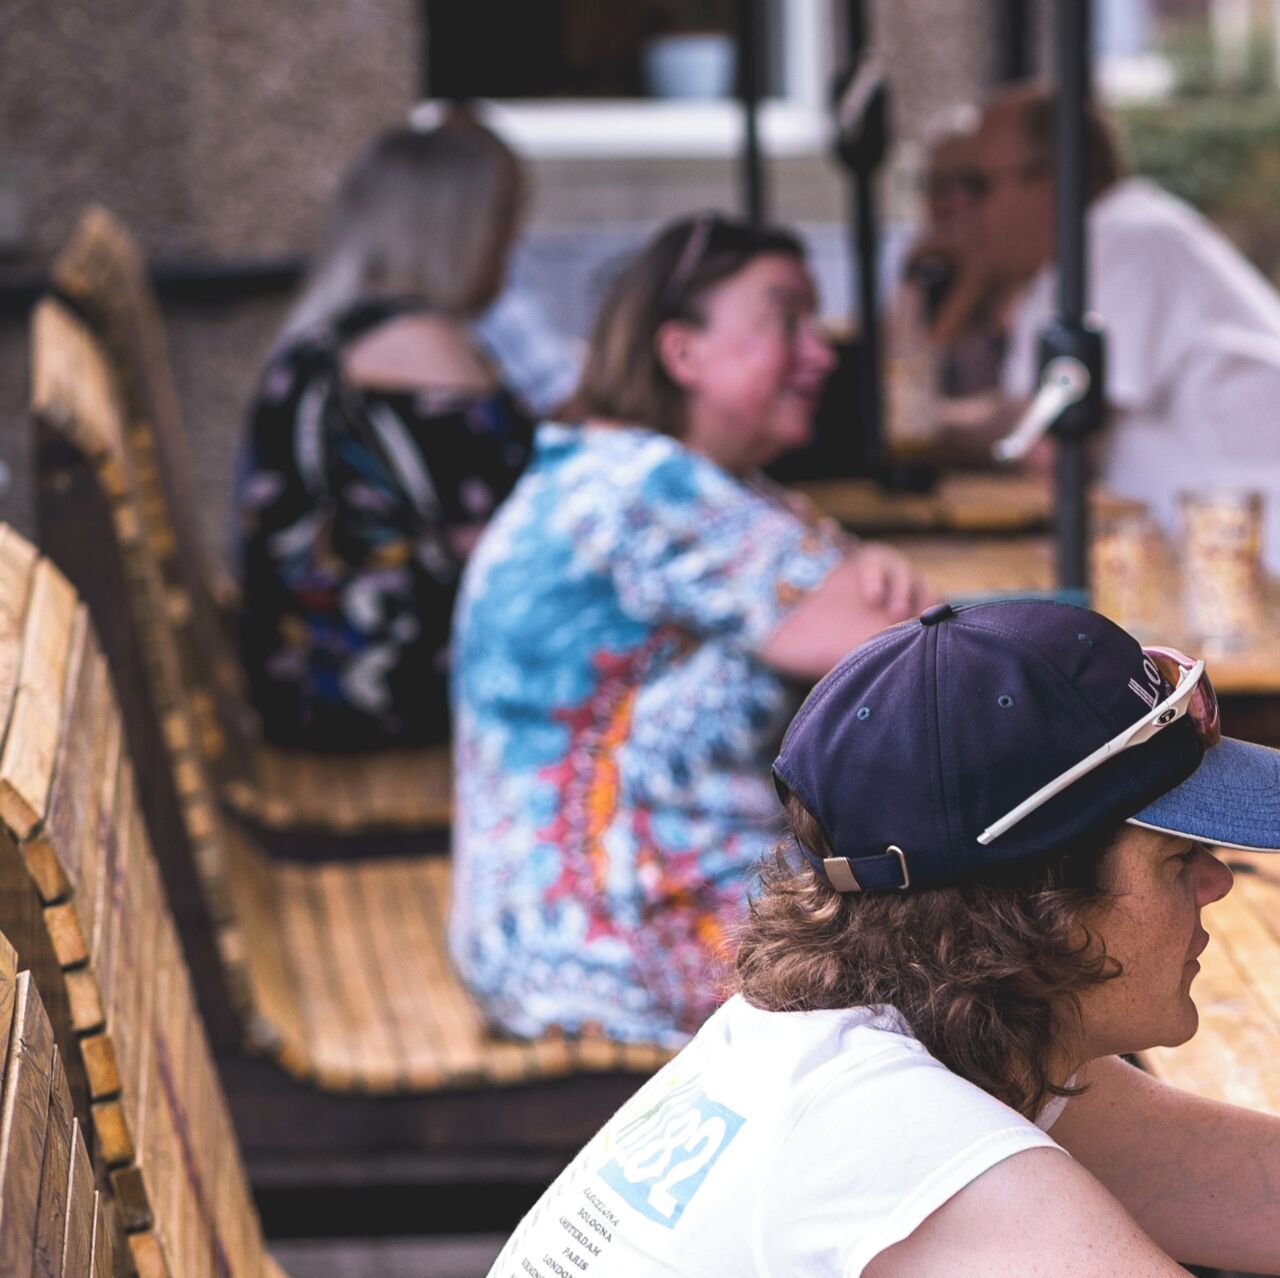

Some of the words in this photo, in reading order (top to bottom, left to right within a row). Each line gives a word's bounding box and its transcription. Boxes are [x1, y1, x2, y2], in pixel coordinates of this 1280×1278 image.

[559, 1216, 602, 1257] AMSTERDAM
[577, 1207, 613, 1243] BOLOGNA
[562, 1246, 589, 1271] PARIS
